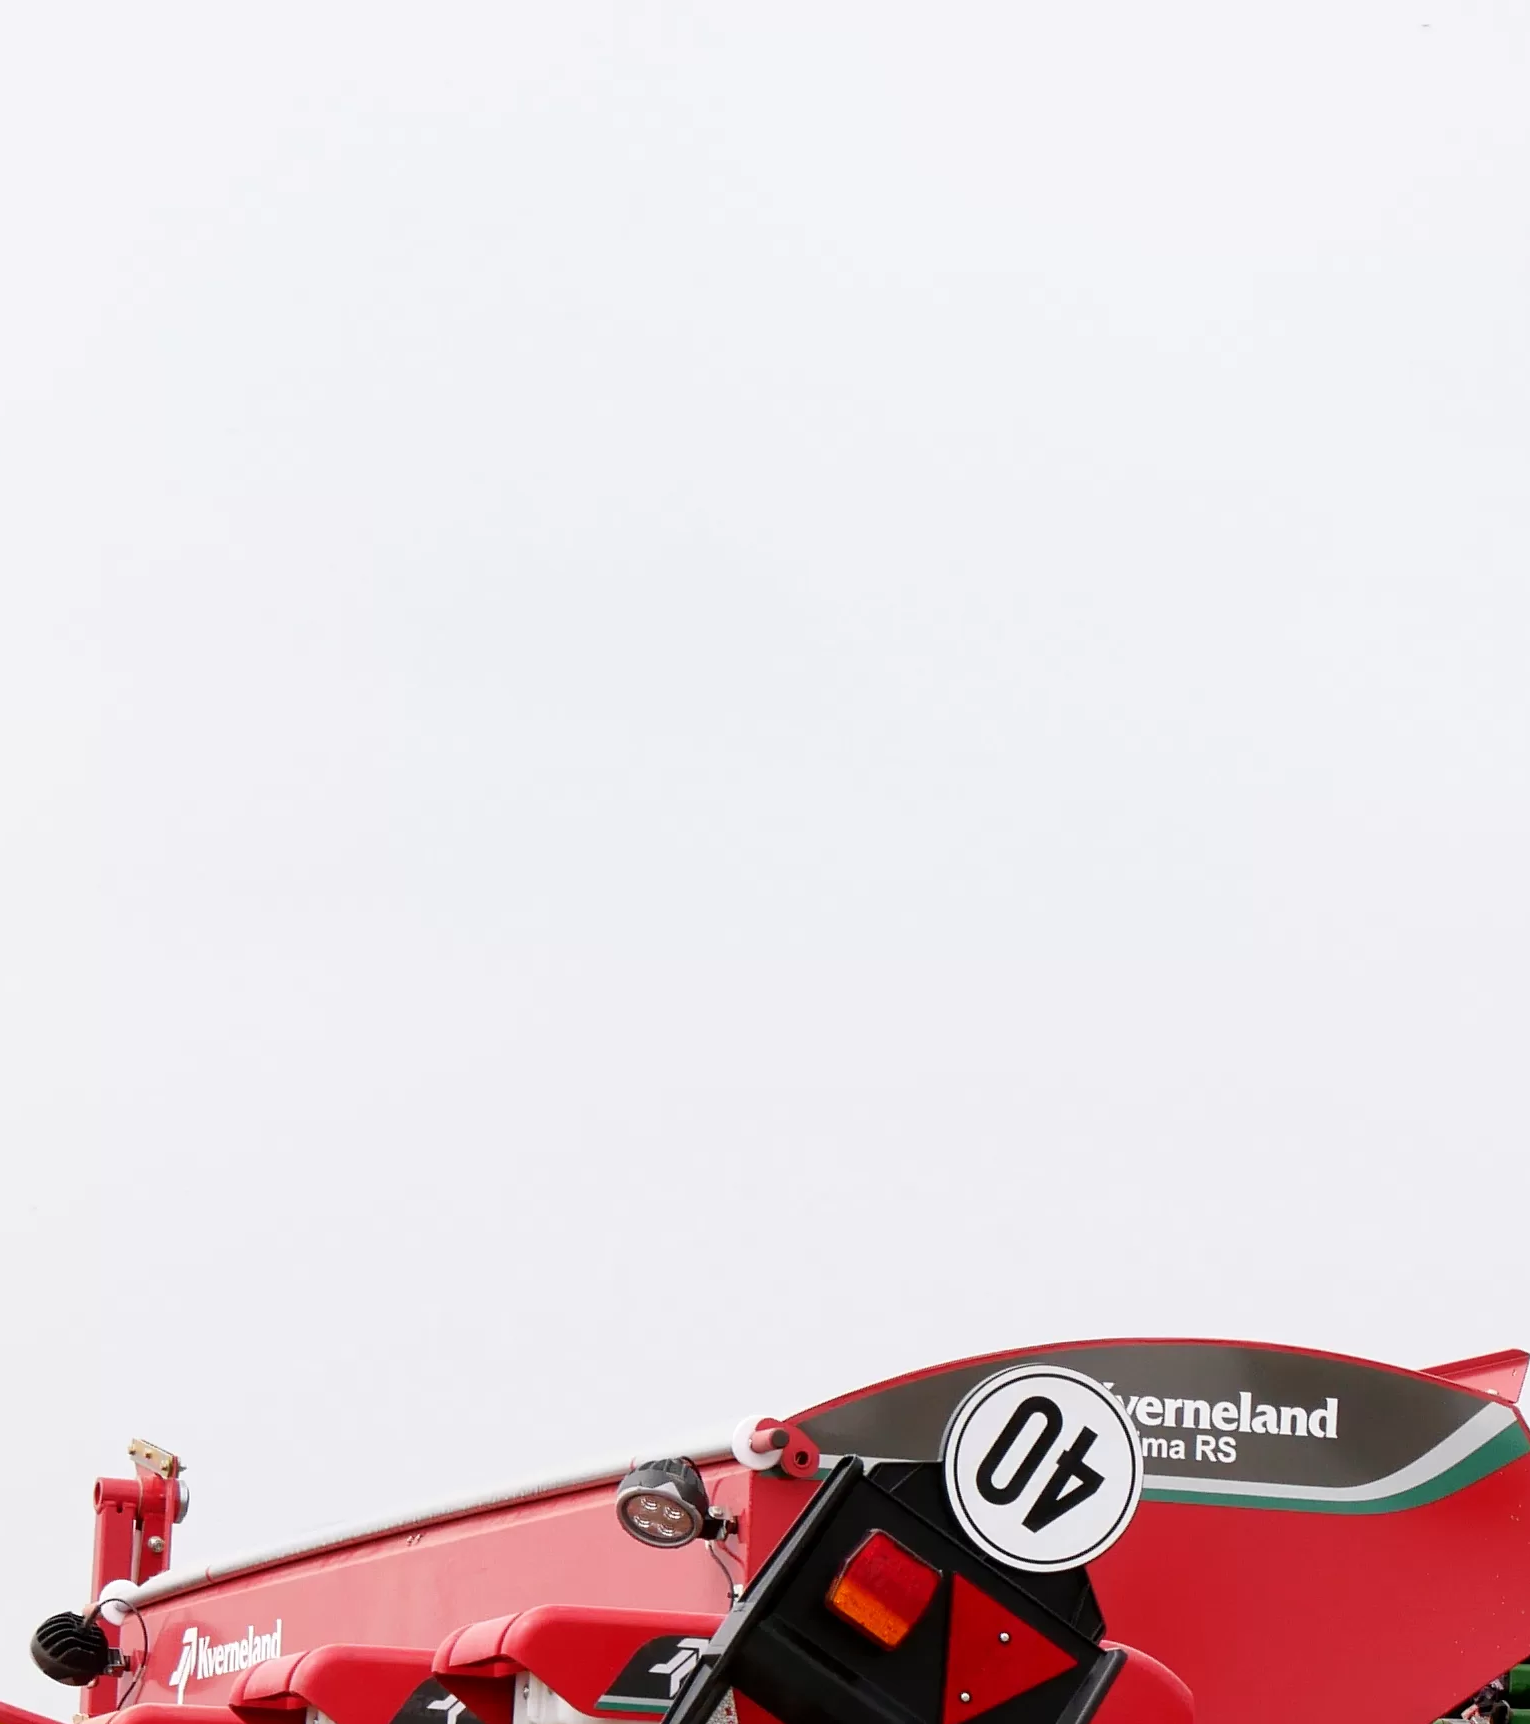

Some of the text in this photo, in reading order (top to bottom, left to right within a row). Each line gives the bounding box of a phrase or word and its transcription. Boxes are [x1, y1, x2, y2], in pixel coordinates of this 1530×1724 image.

[1103, 1382, 1339, 1439] verneland
[976, 1396, 1105, 1533] 40
[1195, 1435, 1237, 1464] RS
[197, 1618, 282, 1680] Kverneland
